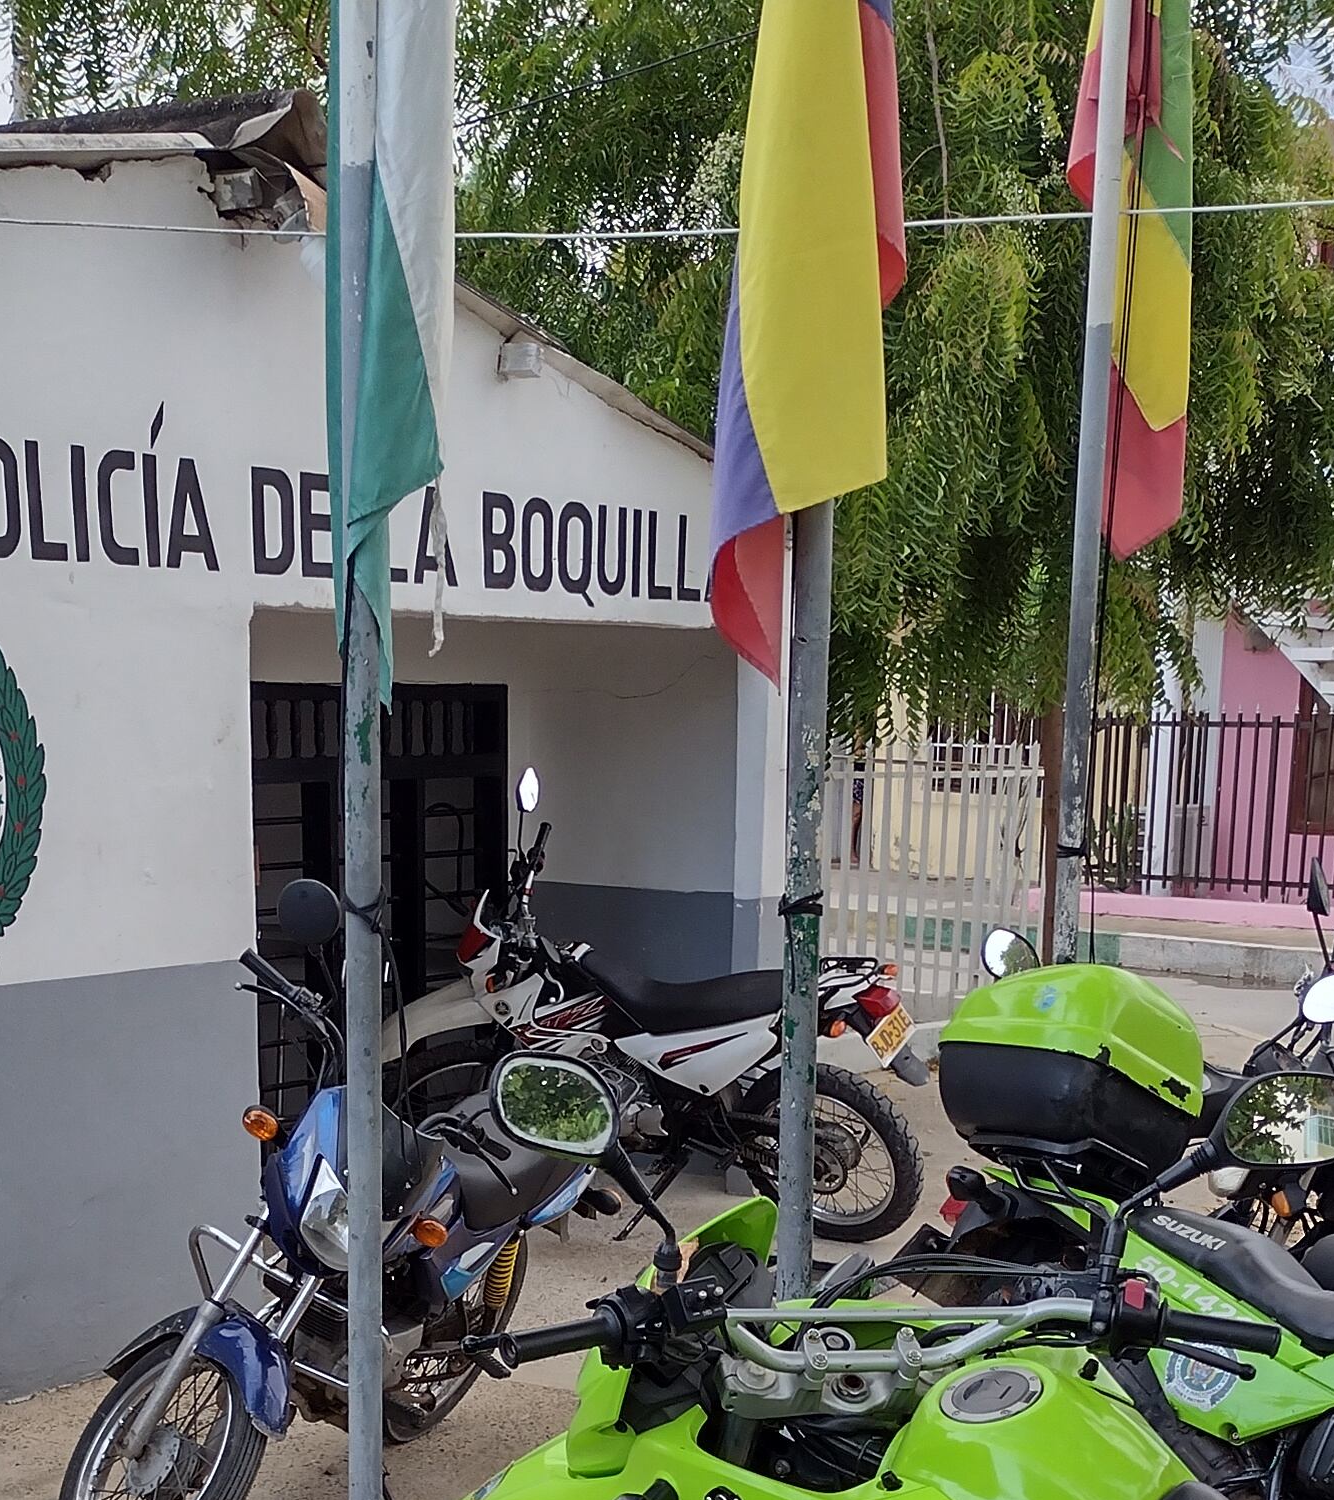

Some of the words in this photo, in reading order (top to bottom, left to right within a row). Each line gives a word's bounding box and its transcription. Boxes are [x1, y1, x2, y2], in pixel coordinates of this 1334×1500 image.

[251, 466, 334, 579] DE
[390, 486, 458, 587] A
[482, 491, 713, 608] BOQUILL
[1152, 1215, 1227, 1250] SUZUKI
